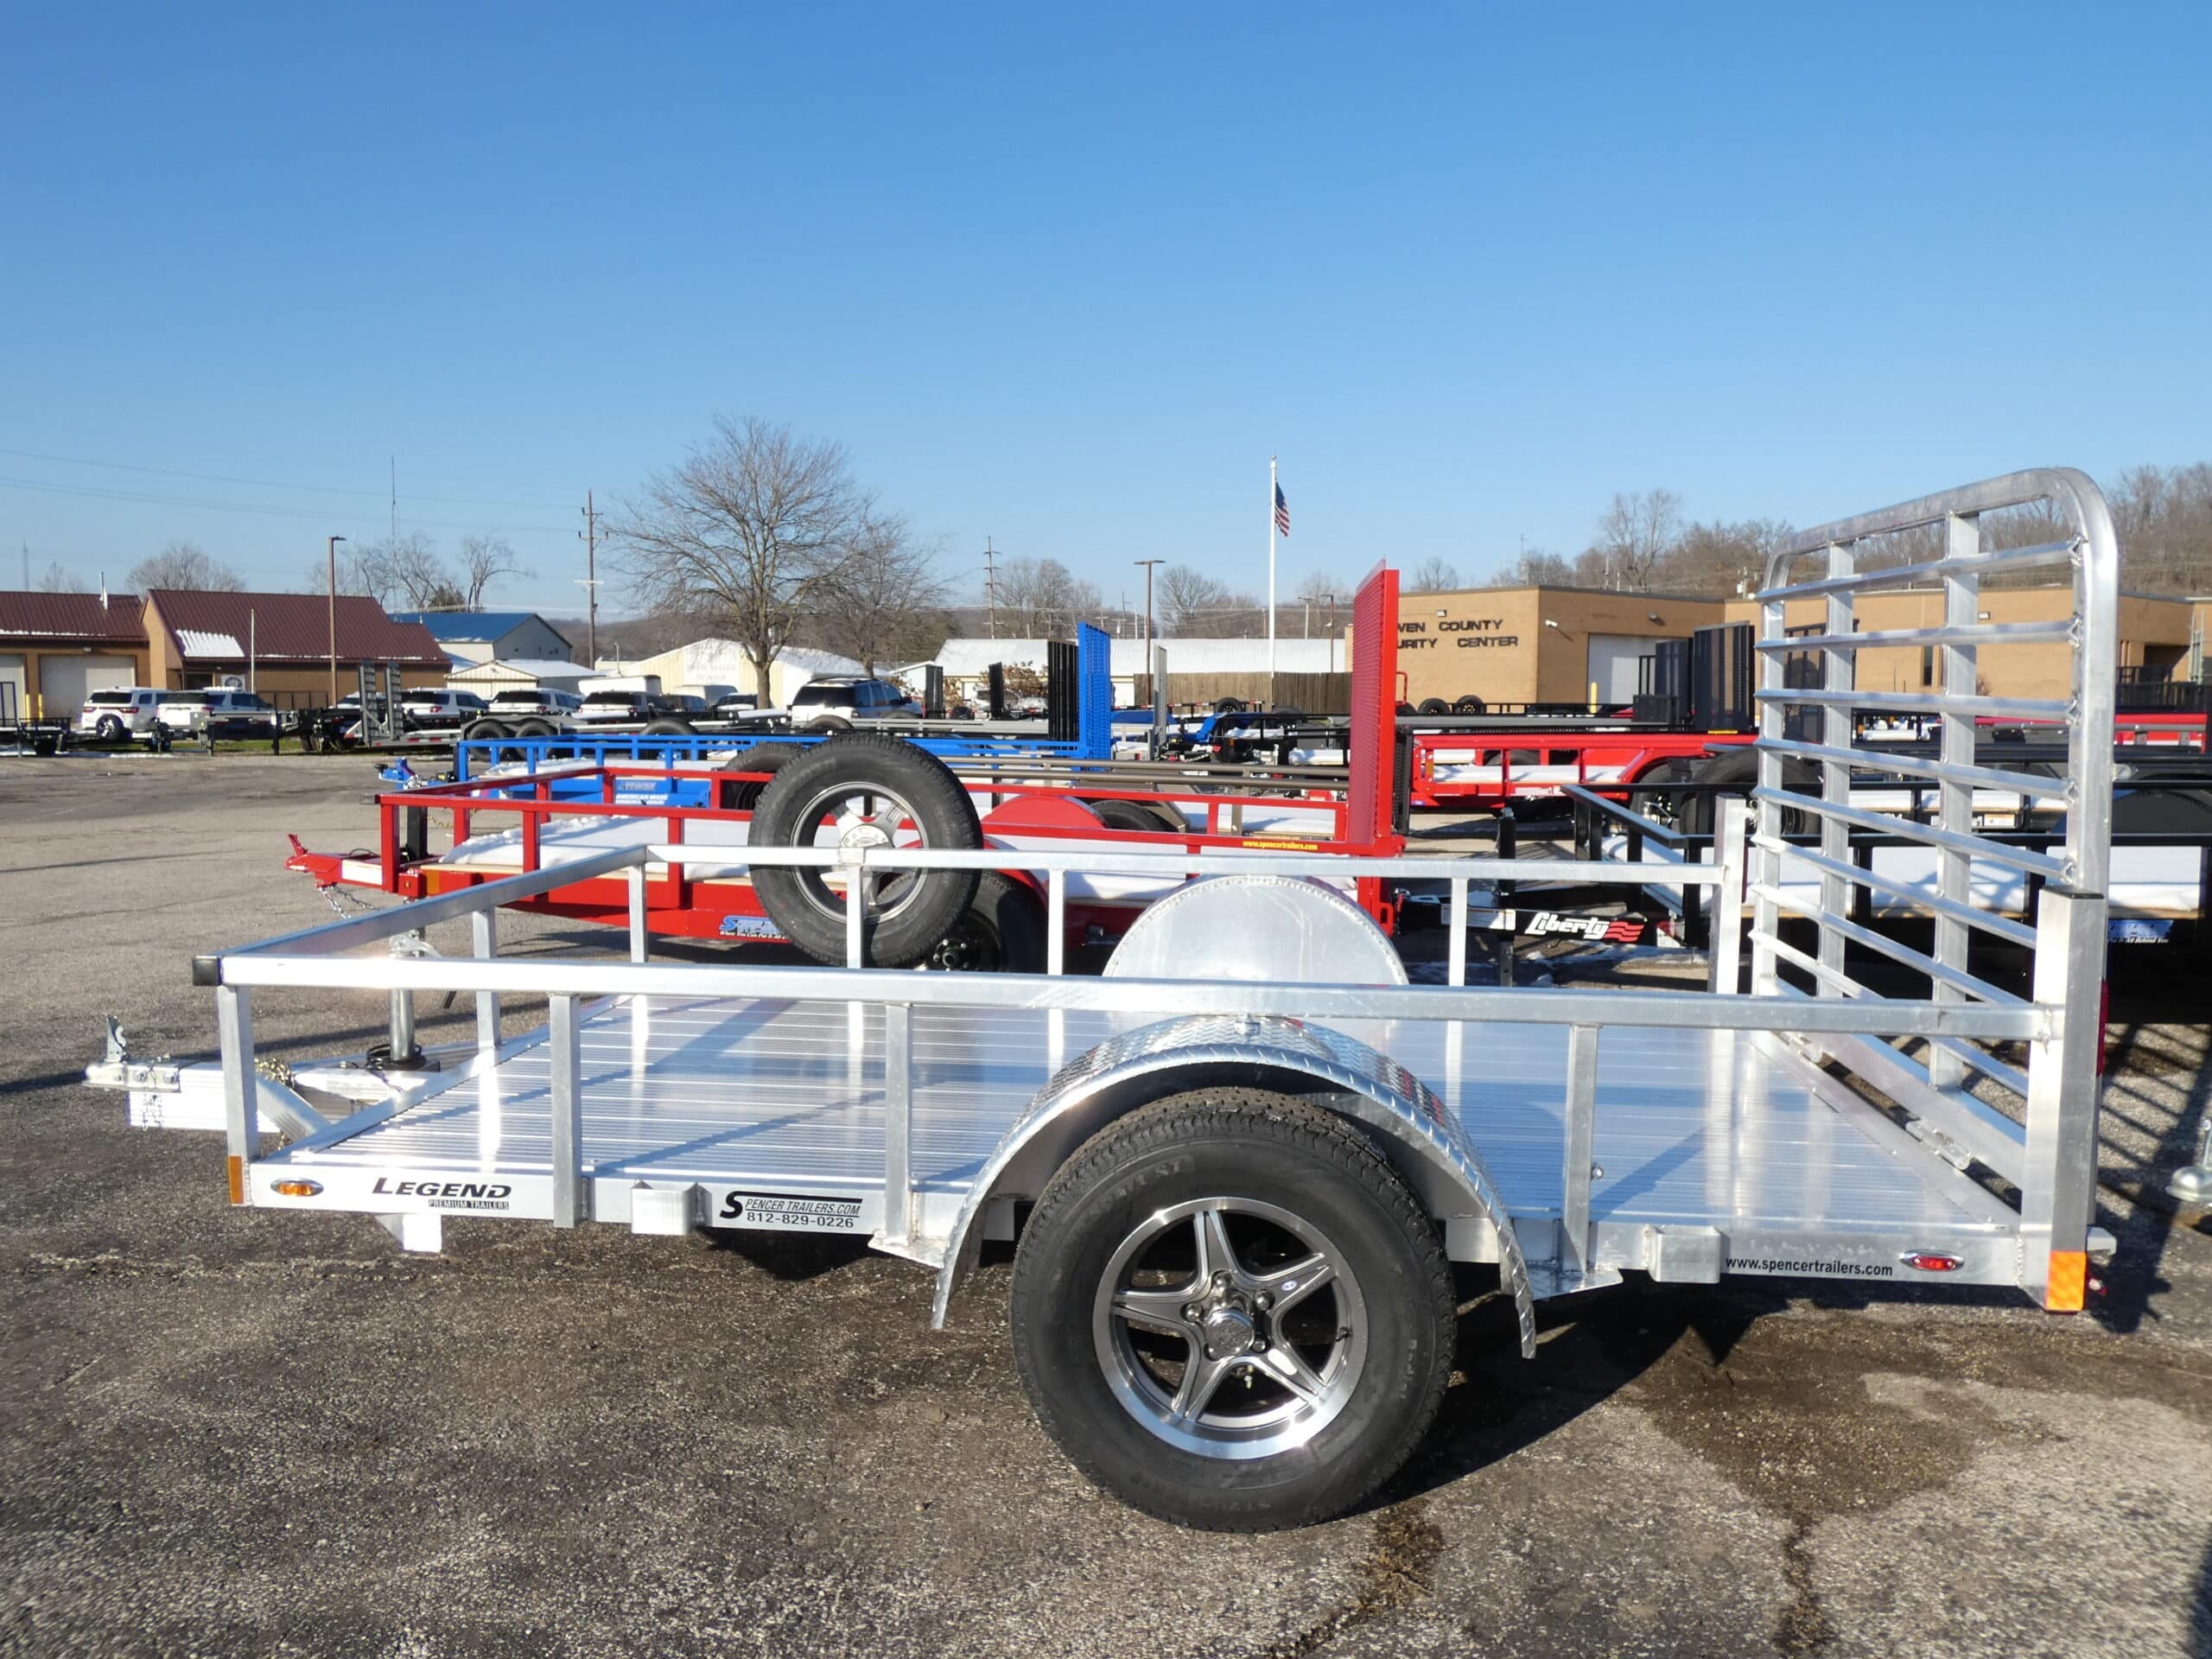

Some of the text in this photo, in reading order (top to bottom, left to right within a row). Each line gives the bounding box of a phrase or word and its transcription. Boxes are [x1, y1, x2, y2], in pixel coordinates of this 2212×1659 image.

[1397, 620, 1503, 632] WEN COUNTY
[1397, 636, 1518, 649] URITY CENTER
[1524, 912, 1611, 940] Liberty
[372, 1177, 512, 1198] LEGEND
[428, 1198, 510, 1210] PREMIUM TRAILERS
[719, 1191, 861, 1219] SPENCER TRAILERS.COM
[747, 1211, 854, 1228] 812-829-0226
[1726, 1256, 1893, 1276] www.spencertrailers.com
